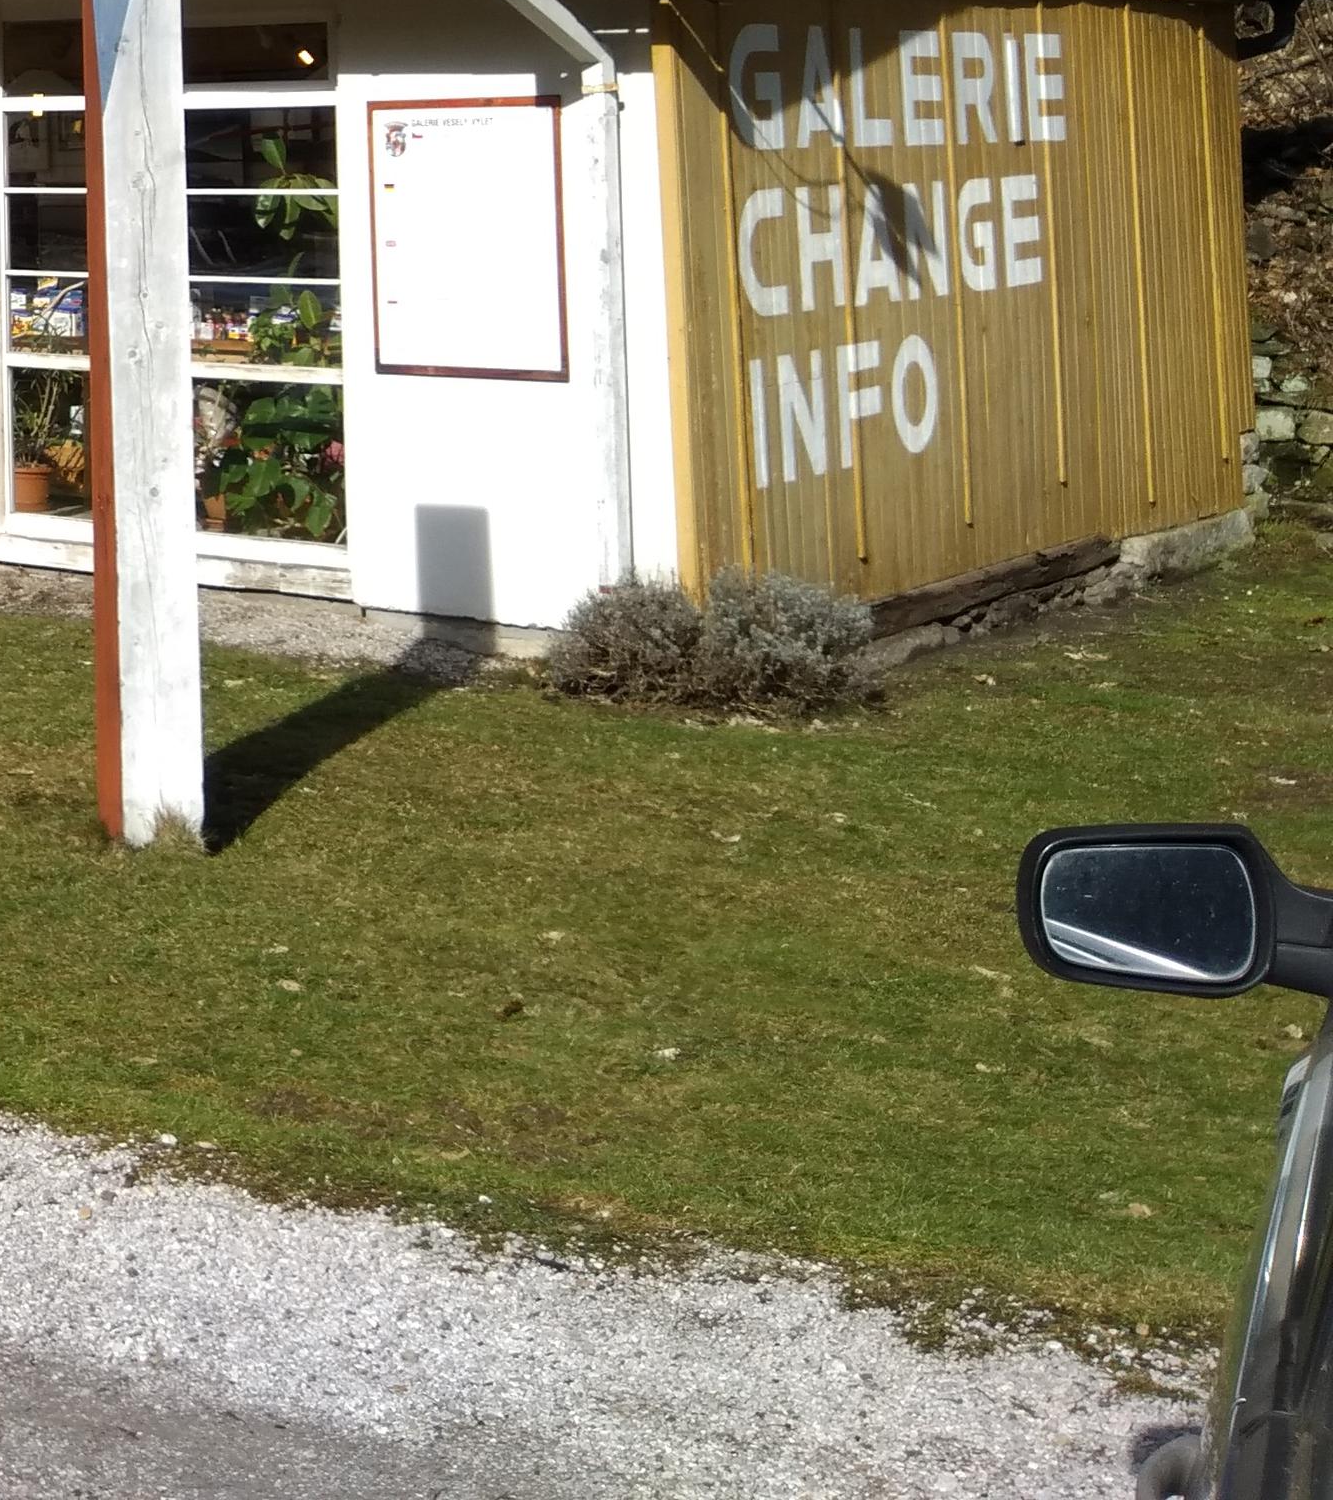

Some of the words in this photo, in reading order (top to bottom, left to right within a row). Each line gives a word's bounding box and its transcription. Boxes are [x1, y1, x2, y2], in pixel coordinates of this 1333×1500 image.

[728, 23, 1066, 151] GALERIE
[738, 173, 1043, 317] CHANGE
[749, 334, 939, 490] INFO
